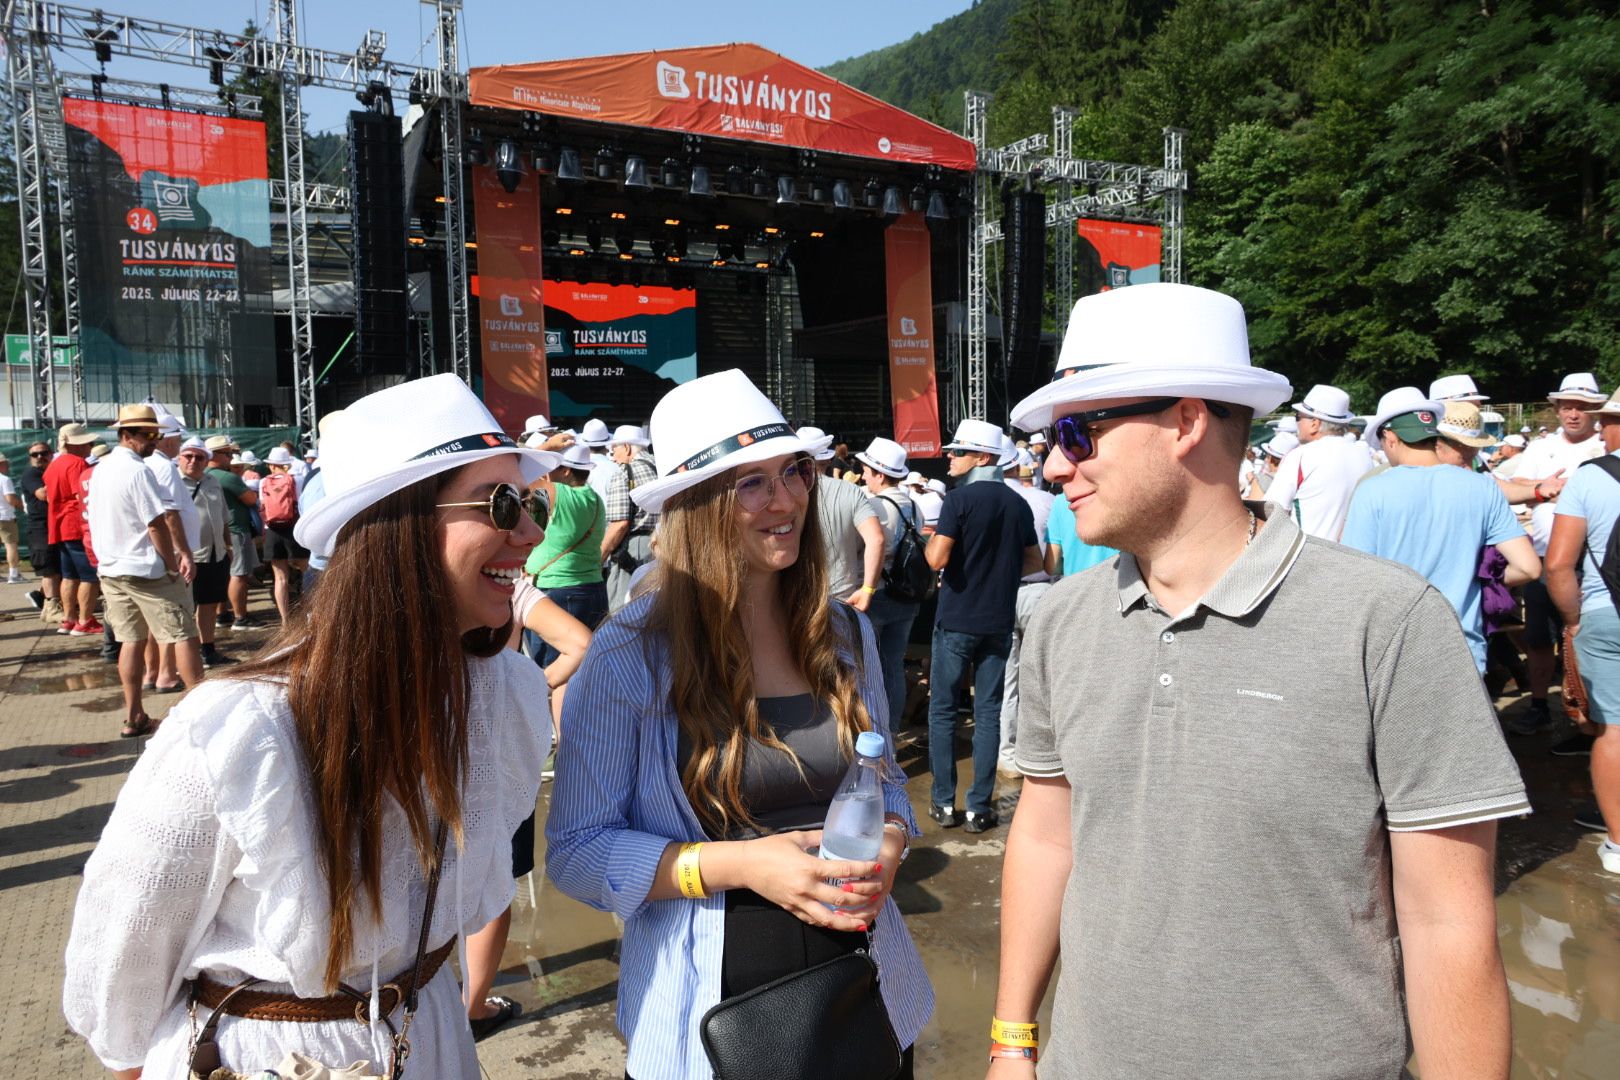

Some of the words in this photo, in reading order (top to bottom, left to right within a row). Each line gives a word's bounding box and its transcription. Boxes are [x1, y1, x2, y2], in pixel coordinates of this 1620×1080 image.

[694, 71, 832, 121] TUSVÁNYOS
[130, 212, 156, 232] 34.
[119, 236, 236, 262] TUSVÁNYOS
[123, 266, 155, 276] RÁNK
[158, 267, 238, 279] SZÁMÍTHATSZ!
[121, 286, 155, 300] 2025.
[161, 284, 201, 301] JÚLIUS
[485, 318, 540, 332] TUSVÁNYOS
[573, 326, 647, 344] TUSVÁNYOS
[574, 347, 596, 356] RÁNK
[550, 367, 572, 377] 2025.
[574, 365, 600, 377] JÚLIUS
